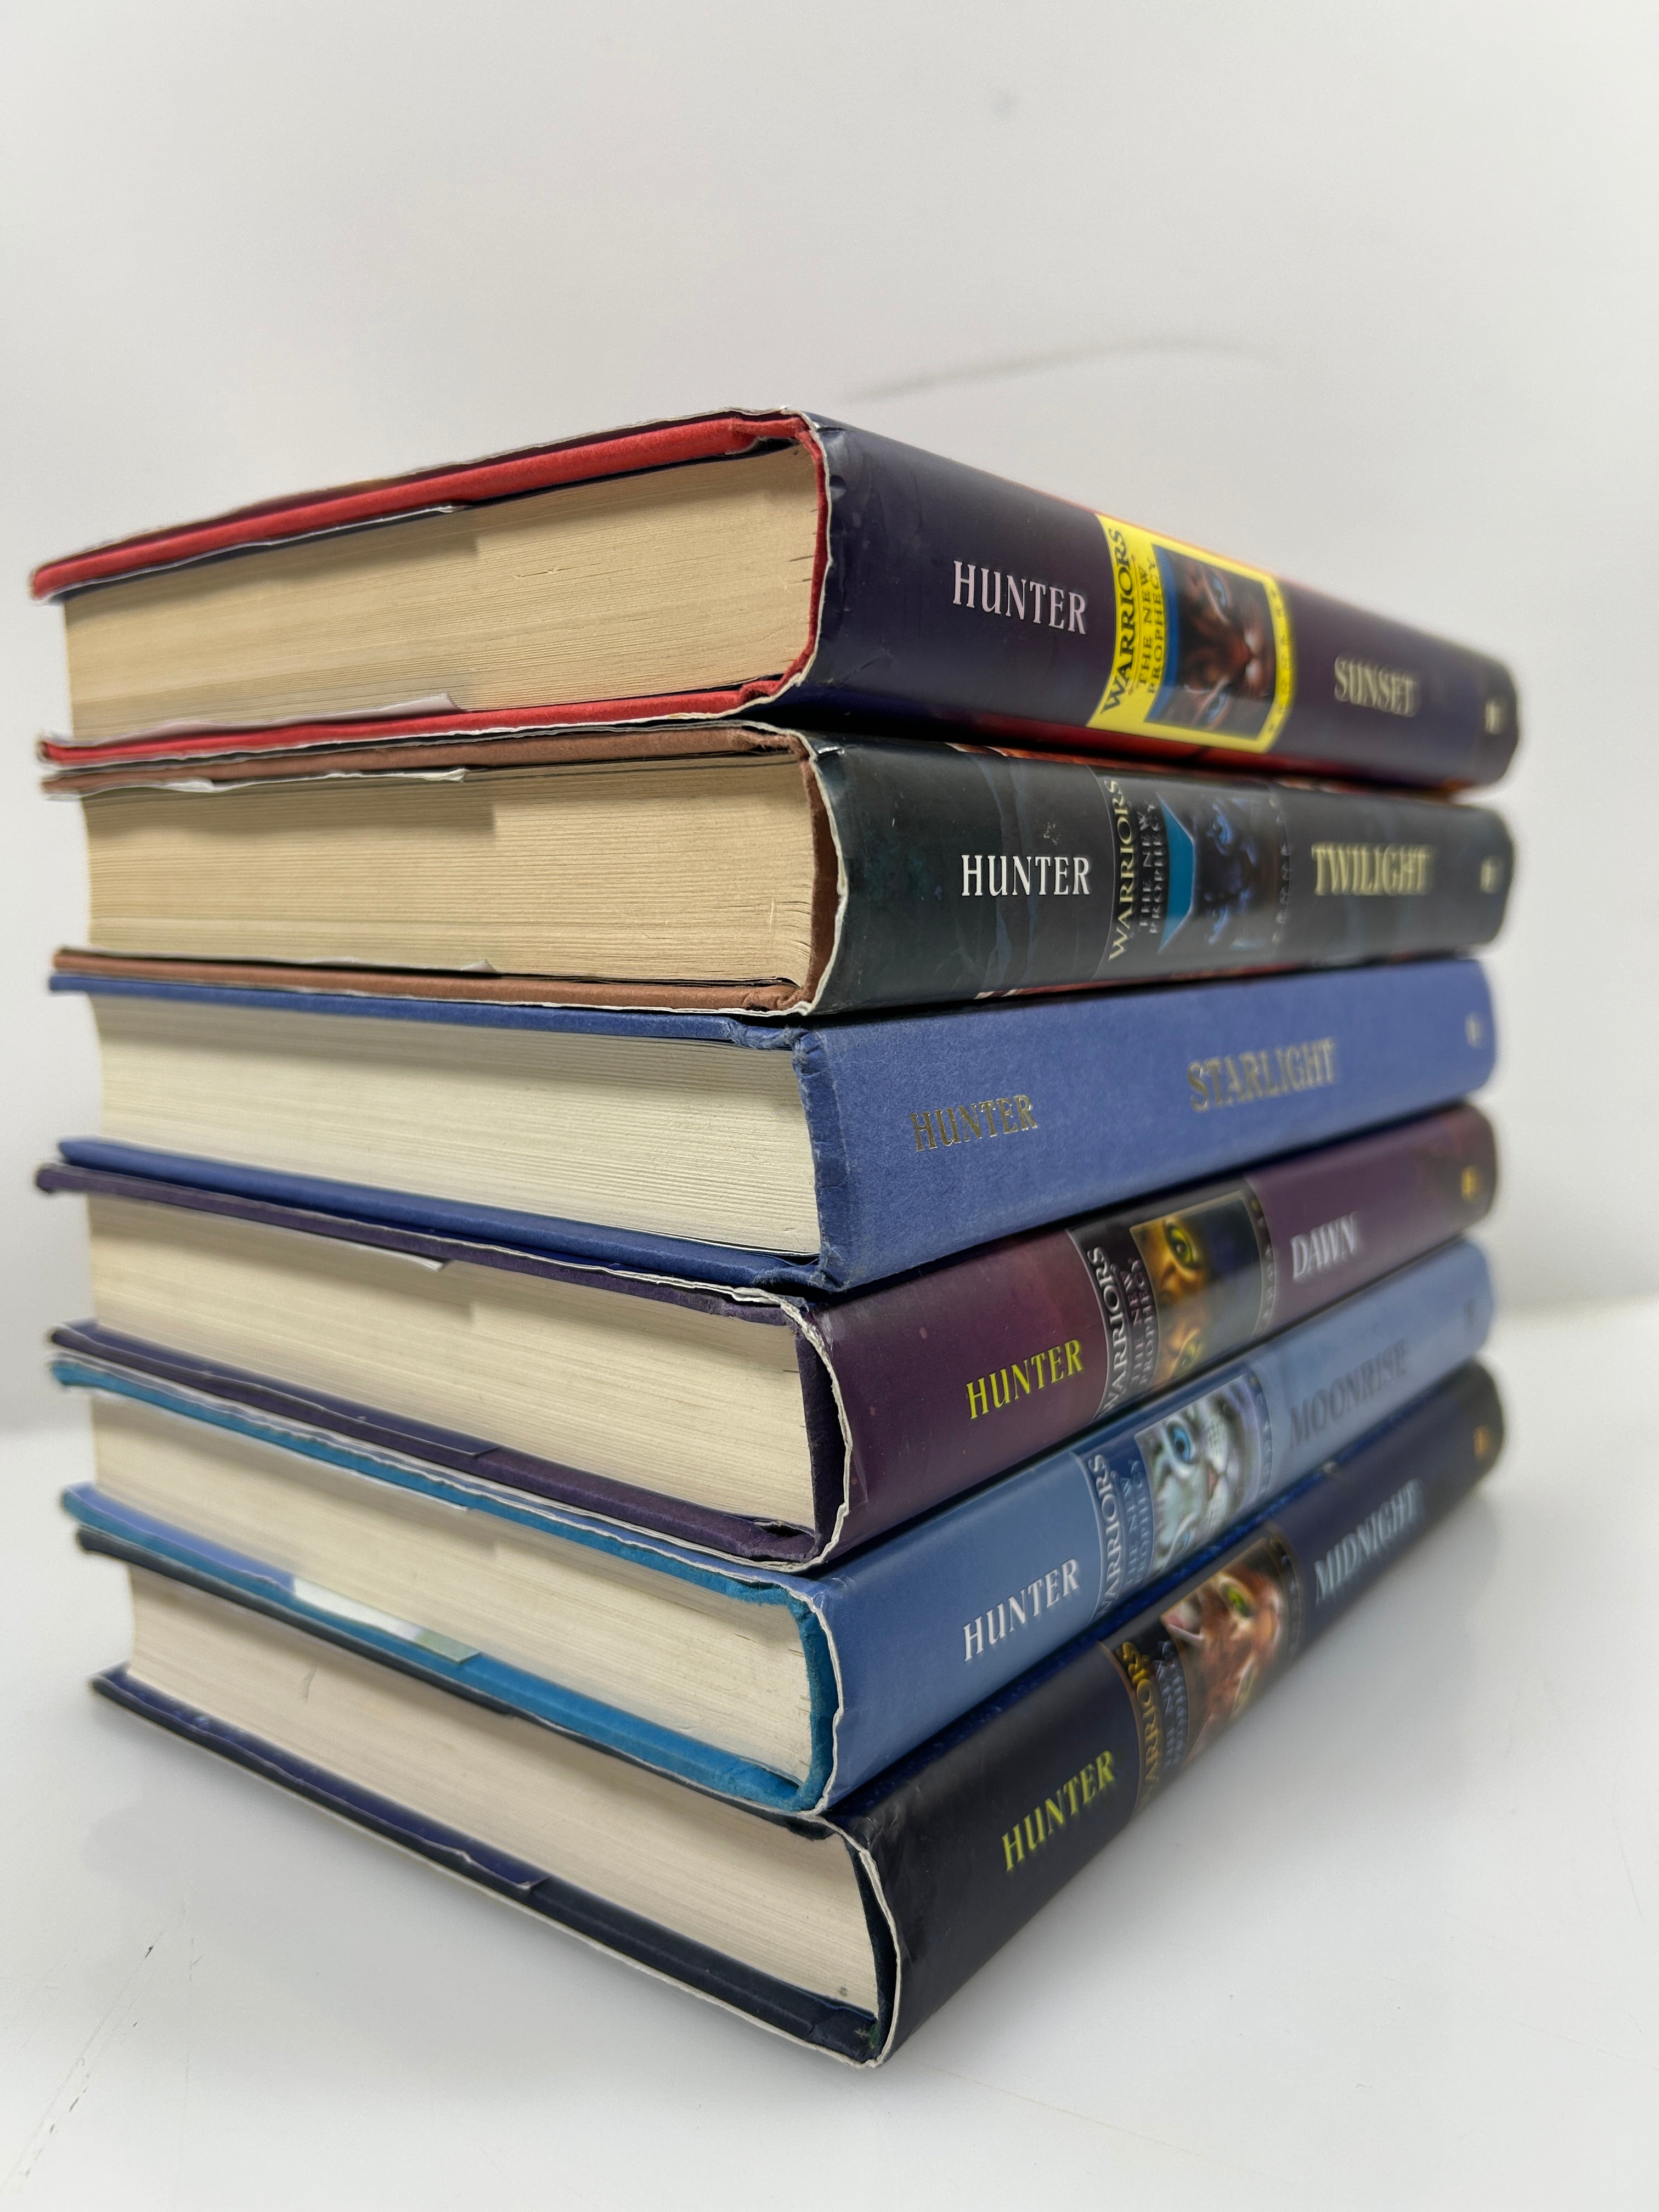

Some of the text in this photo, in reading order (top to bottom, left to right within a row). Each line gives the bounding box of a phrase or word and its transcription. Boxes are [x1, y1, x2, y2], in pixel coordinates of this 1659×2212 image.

[953, 560, 1086, 635] HUNTER
[1101, 528, 1136, 714] WARRIORS
[1138, 565, 1152, 687] THE NEW
[1147, 557, 1164, 694] PROPHECY
[1334, 654, 1417, 718] SUNSET
[961, 854, 1090, 896] HUNTER
[1105, 780, 1137, 961] WARRIORS
[1311, 842, 1431, 896] TWILIGHT
[911, 1094, 1038, 1152] HUNTER
[1187, 1039, 1335, 1112] STARLIGHT
[1290, 1211, 1359, 1283] DAWN
[966, 1339, 1083, 1420] HUNTER
[1087, 1246, 1128, 1410] WARRIORS
[1289, 1338, 1408, 1448] MOONRISE
[1314, 1479, 1422, 1605] MIDNIGHT
[964, 1558, 1080, 1662] HUNTER
[1001, 1750, 1116, 1872] HUNTER
